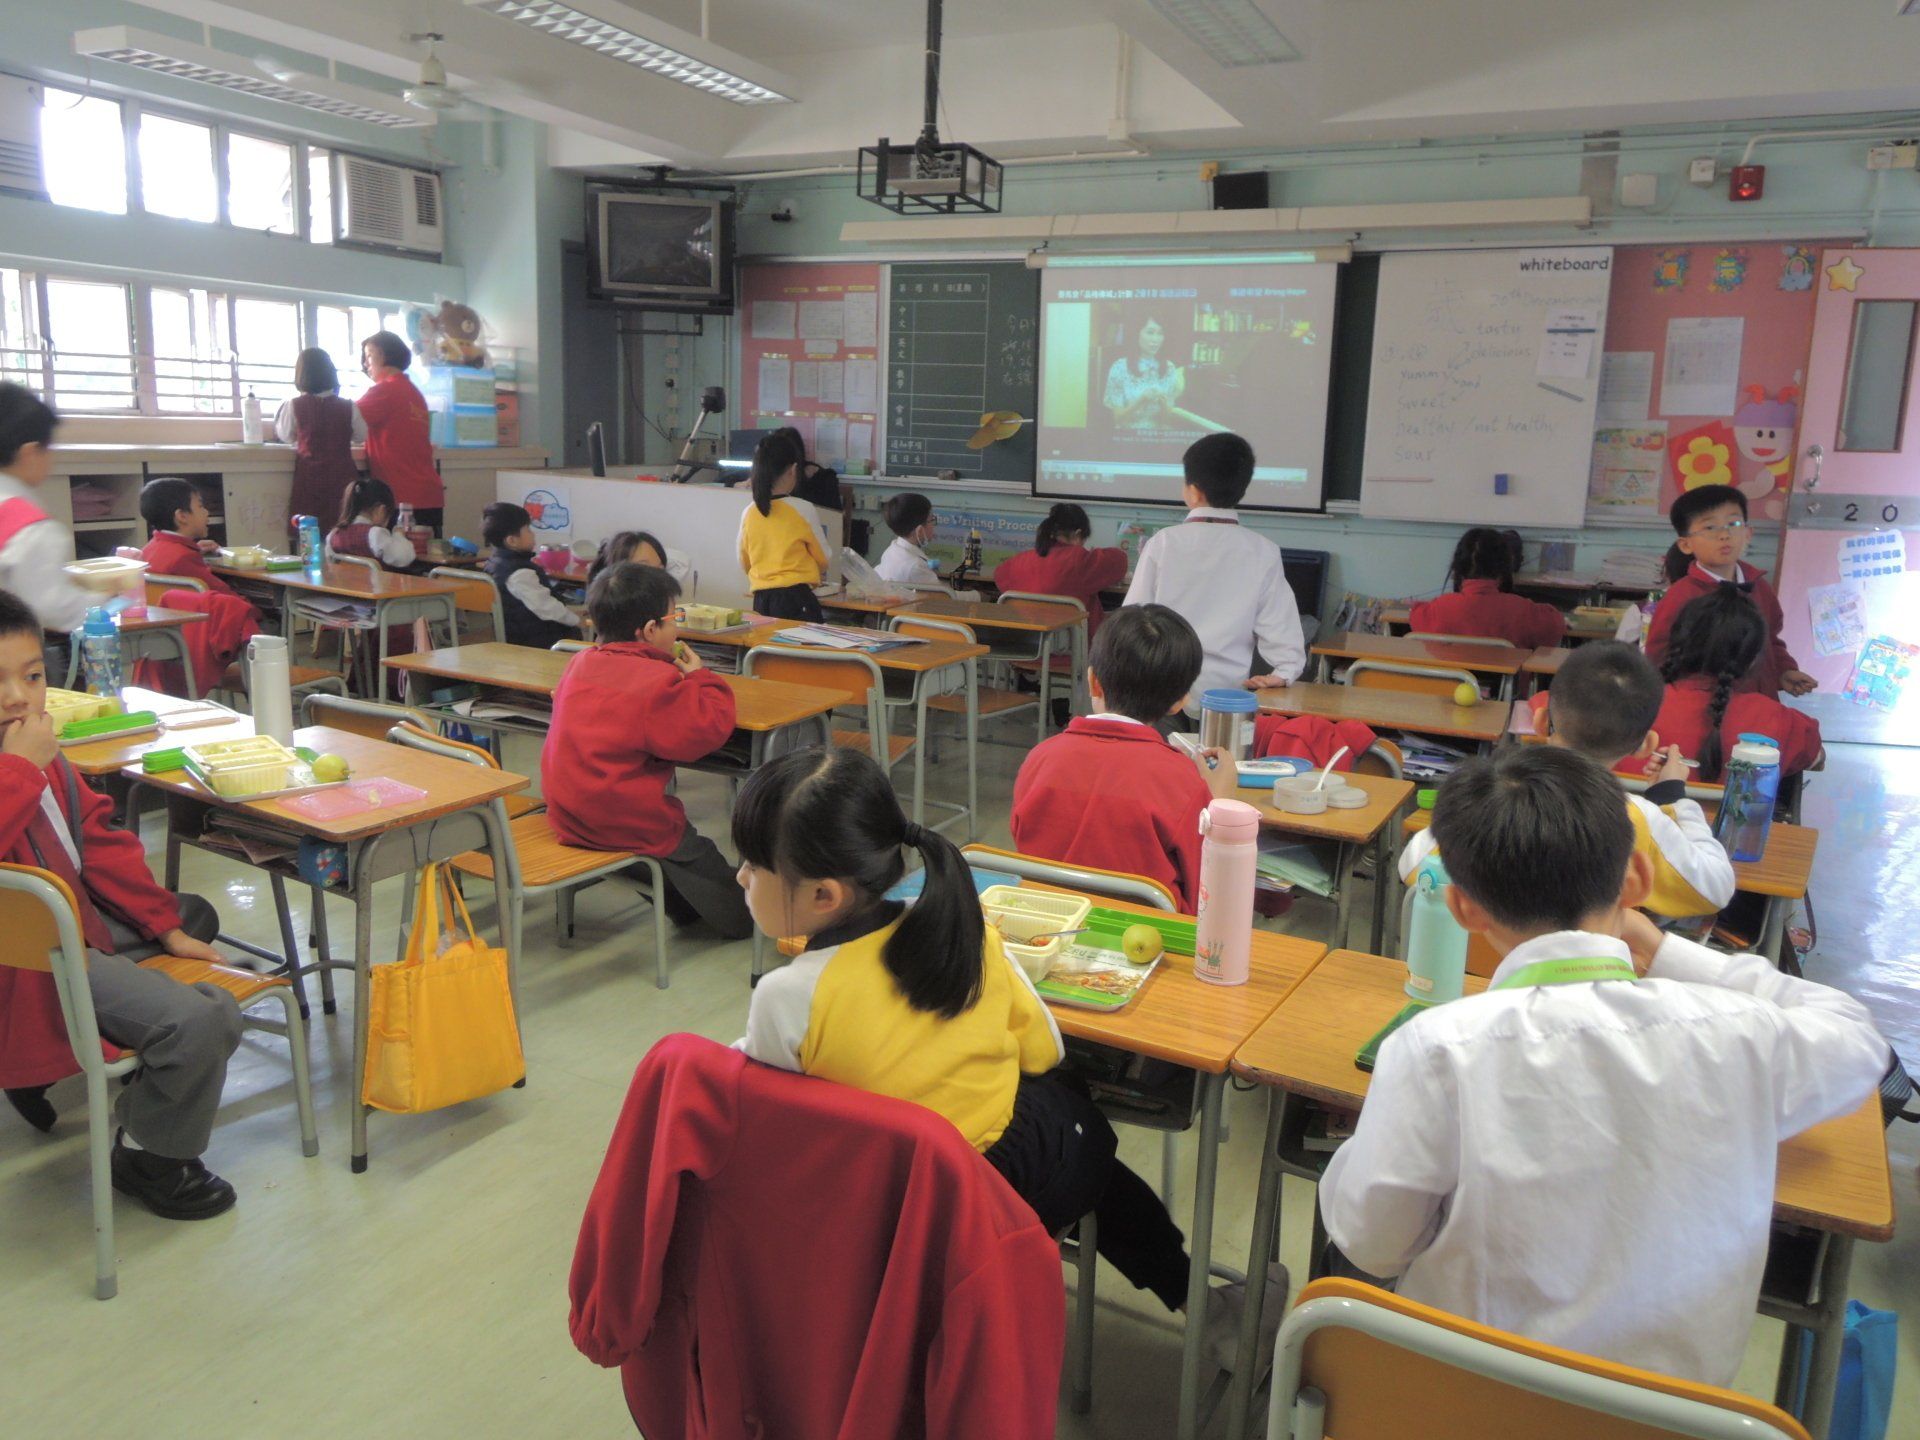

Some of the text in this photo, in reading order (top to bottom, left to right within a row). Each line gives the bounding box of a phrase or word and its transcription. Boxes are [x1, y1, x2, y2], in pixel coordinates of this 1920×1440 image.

[1520, 256, 1609, 272] whiteboard
[1506, 412, 1555, 439] healthy
[1845, 502, 1898, 522] 2 0
